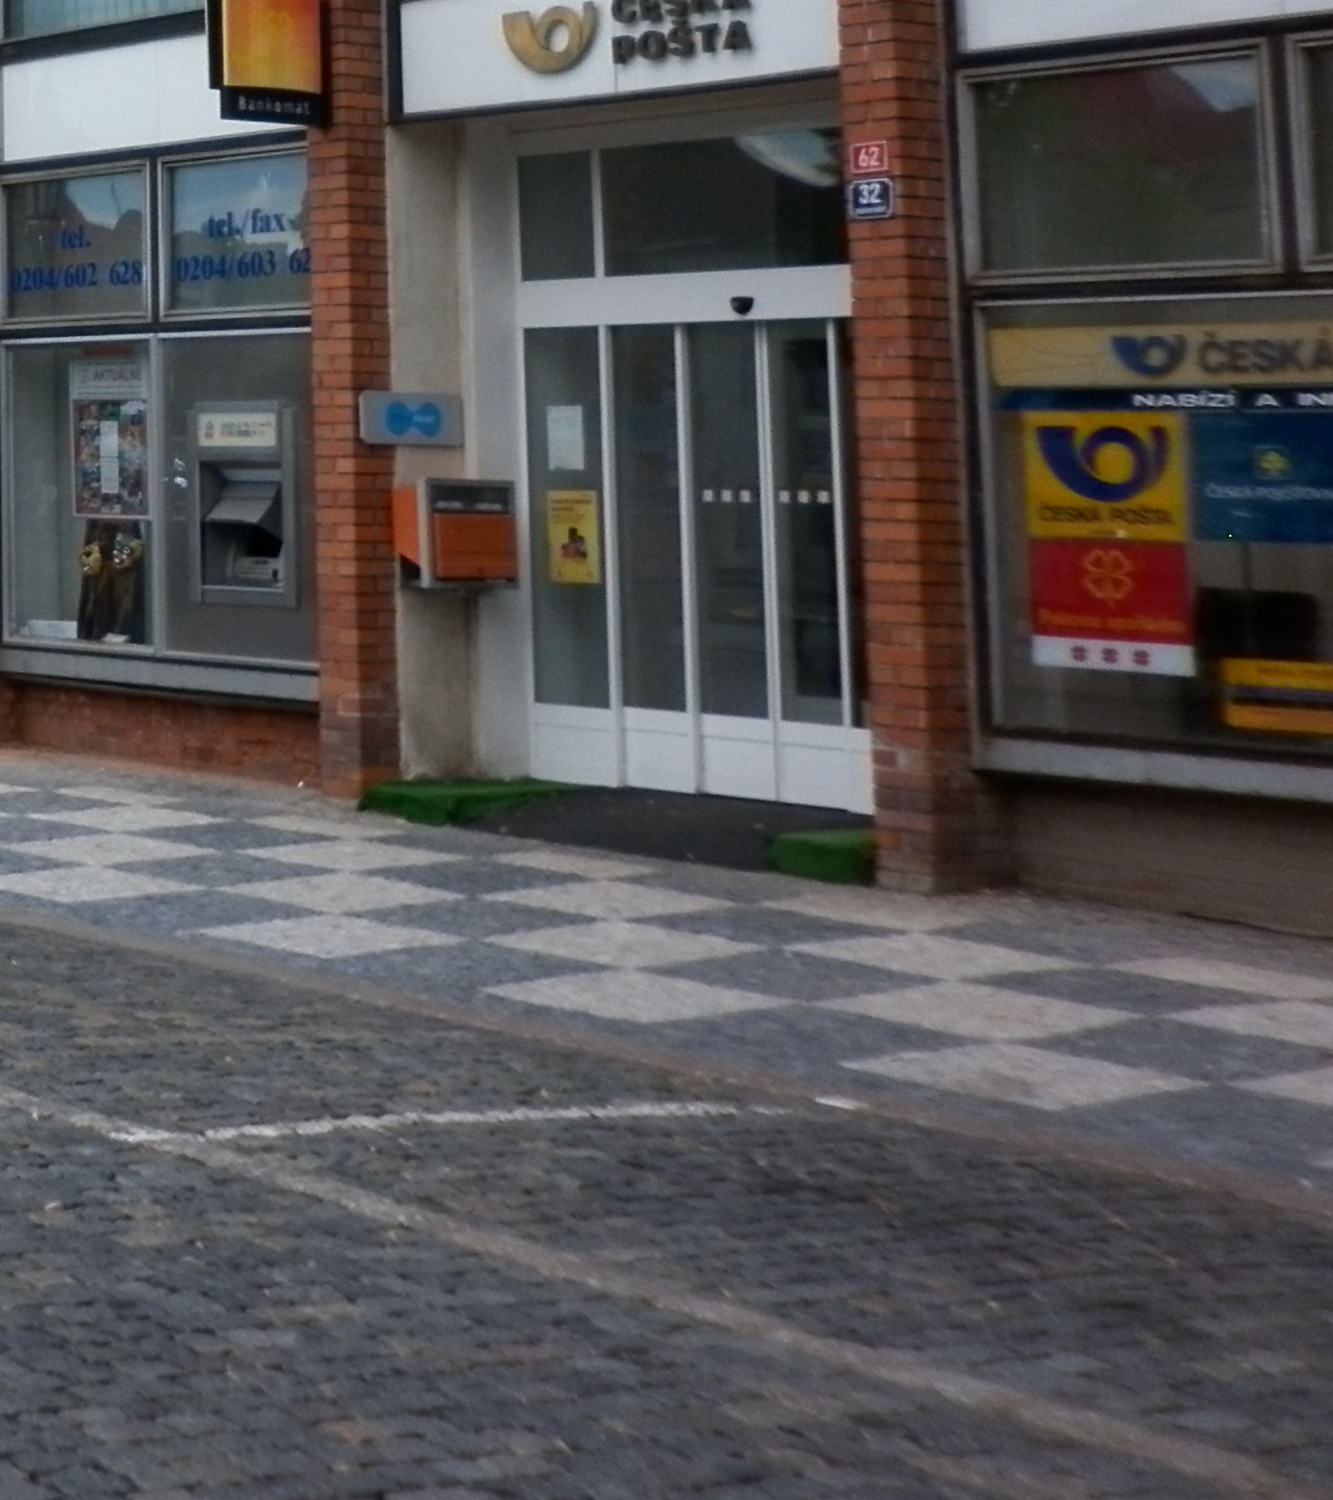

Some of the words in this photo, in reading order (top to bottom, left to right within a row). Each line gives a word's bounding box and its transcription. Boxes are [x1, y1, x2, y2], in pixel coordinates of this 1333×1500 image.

[611, 19, 754, 65] POŠTA
[238, 95, 310, 115] Bankomat
[858, 146, 881, 167] 62
[858, 182, 882, 205] 32
[289, 248, 311, 274] 62
[109, 260, 142, 286] 628
[1255, 393, 1280, 407] A
